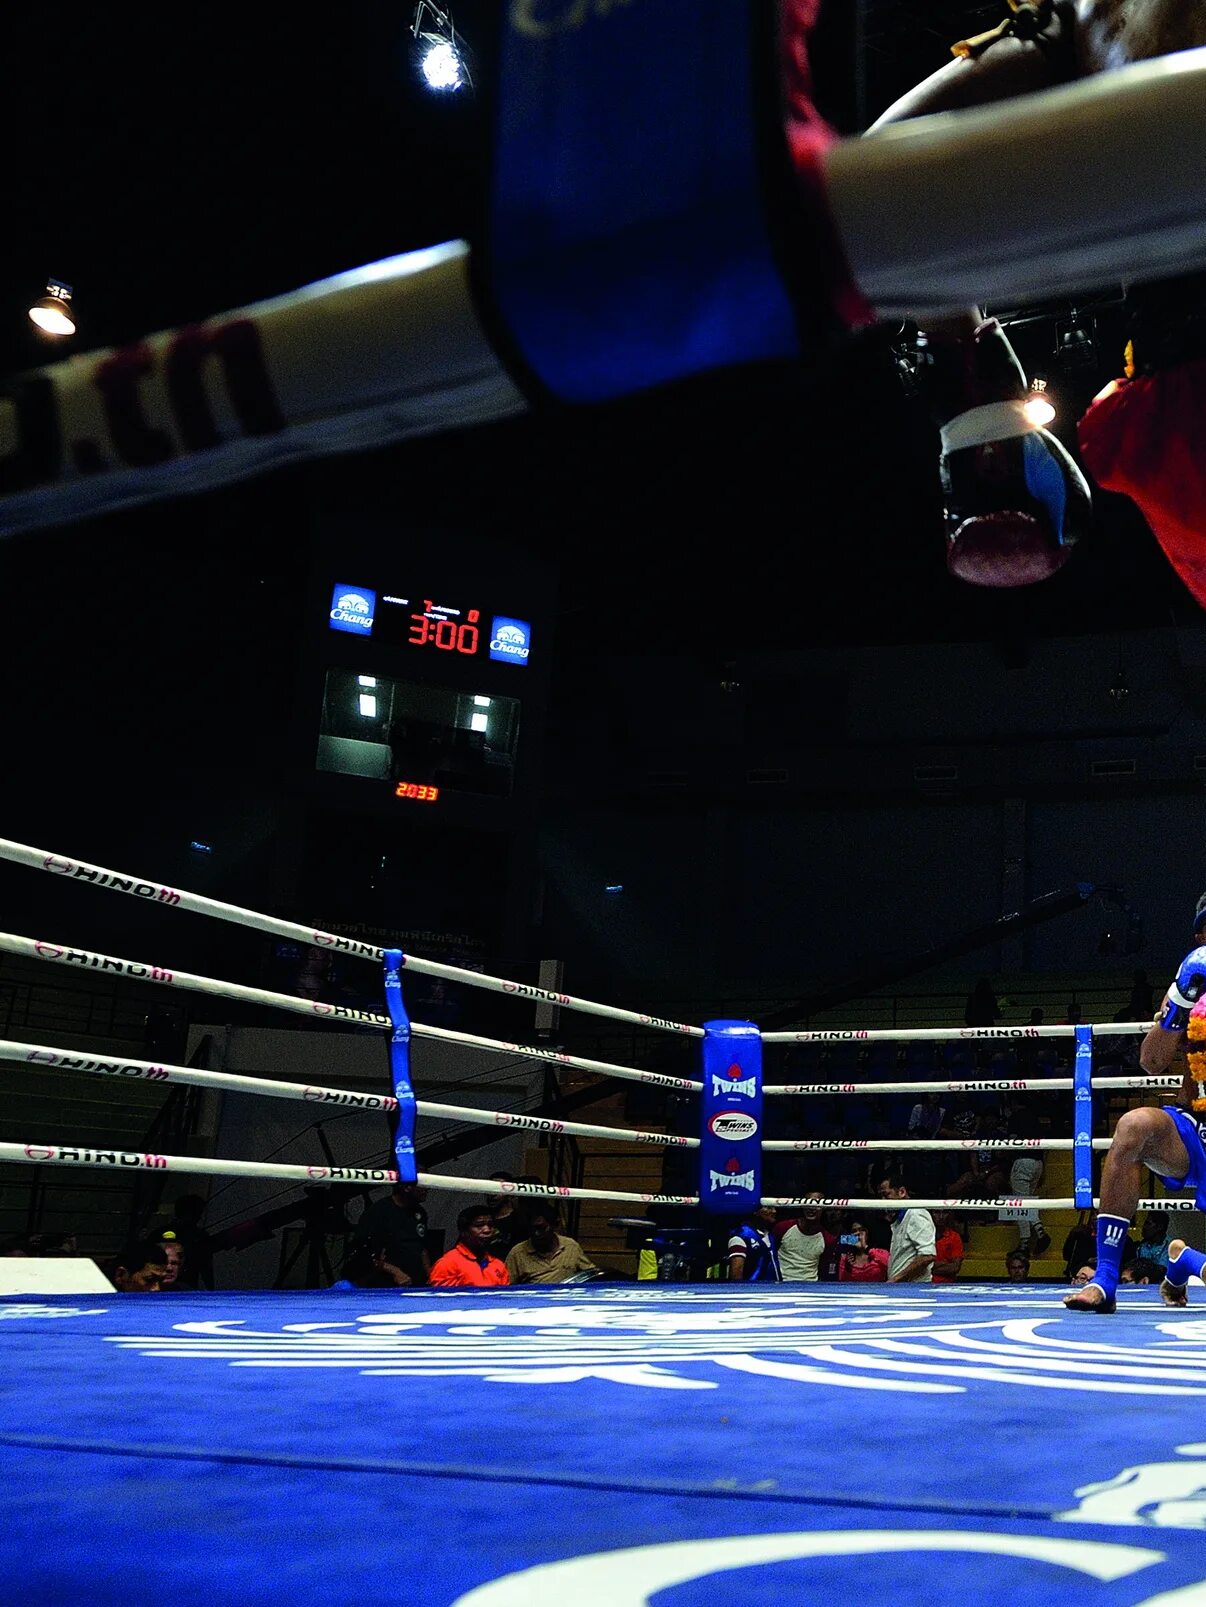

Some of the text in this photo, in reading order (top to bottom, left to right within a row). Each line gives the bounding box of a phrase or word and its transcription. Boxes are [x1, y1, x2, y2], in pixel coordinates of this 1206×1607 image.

[330, 608, 373, 628] Chang
[408, 614, 479, 655] 3:00
[490, 640, 530, 658] Chang
[396, 782, 439, 801] 2033
[73, 866, 181, 905] HINO.th
[66, 950, 173, 983] HINO.th
[977, 1028, 1039, 1038] HINO.th
[57, 1057, 169, 1081] HINO.th
[712, 1073, 757, 1099] TWINS
[965, 1081, 1027, 1090] HINO.th
[511, 1116, 563, 1132] HINO.th
[710, 1169, 755, 1192] TWINS
